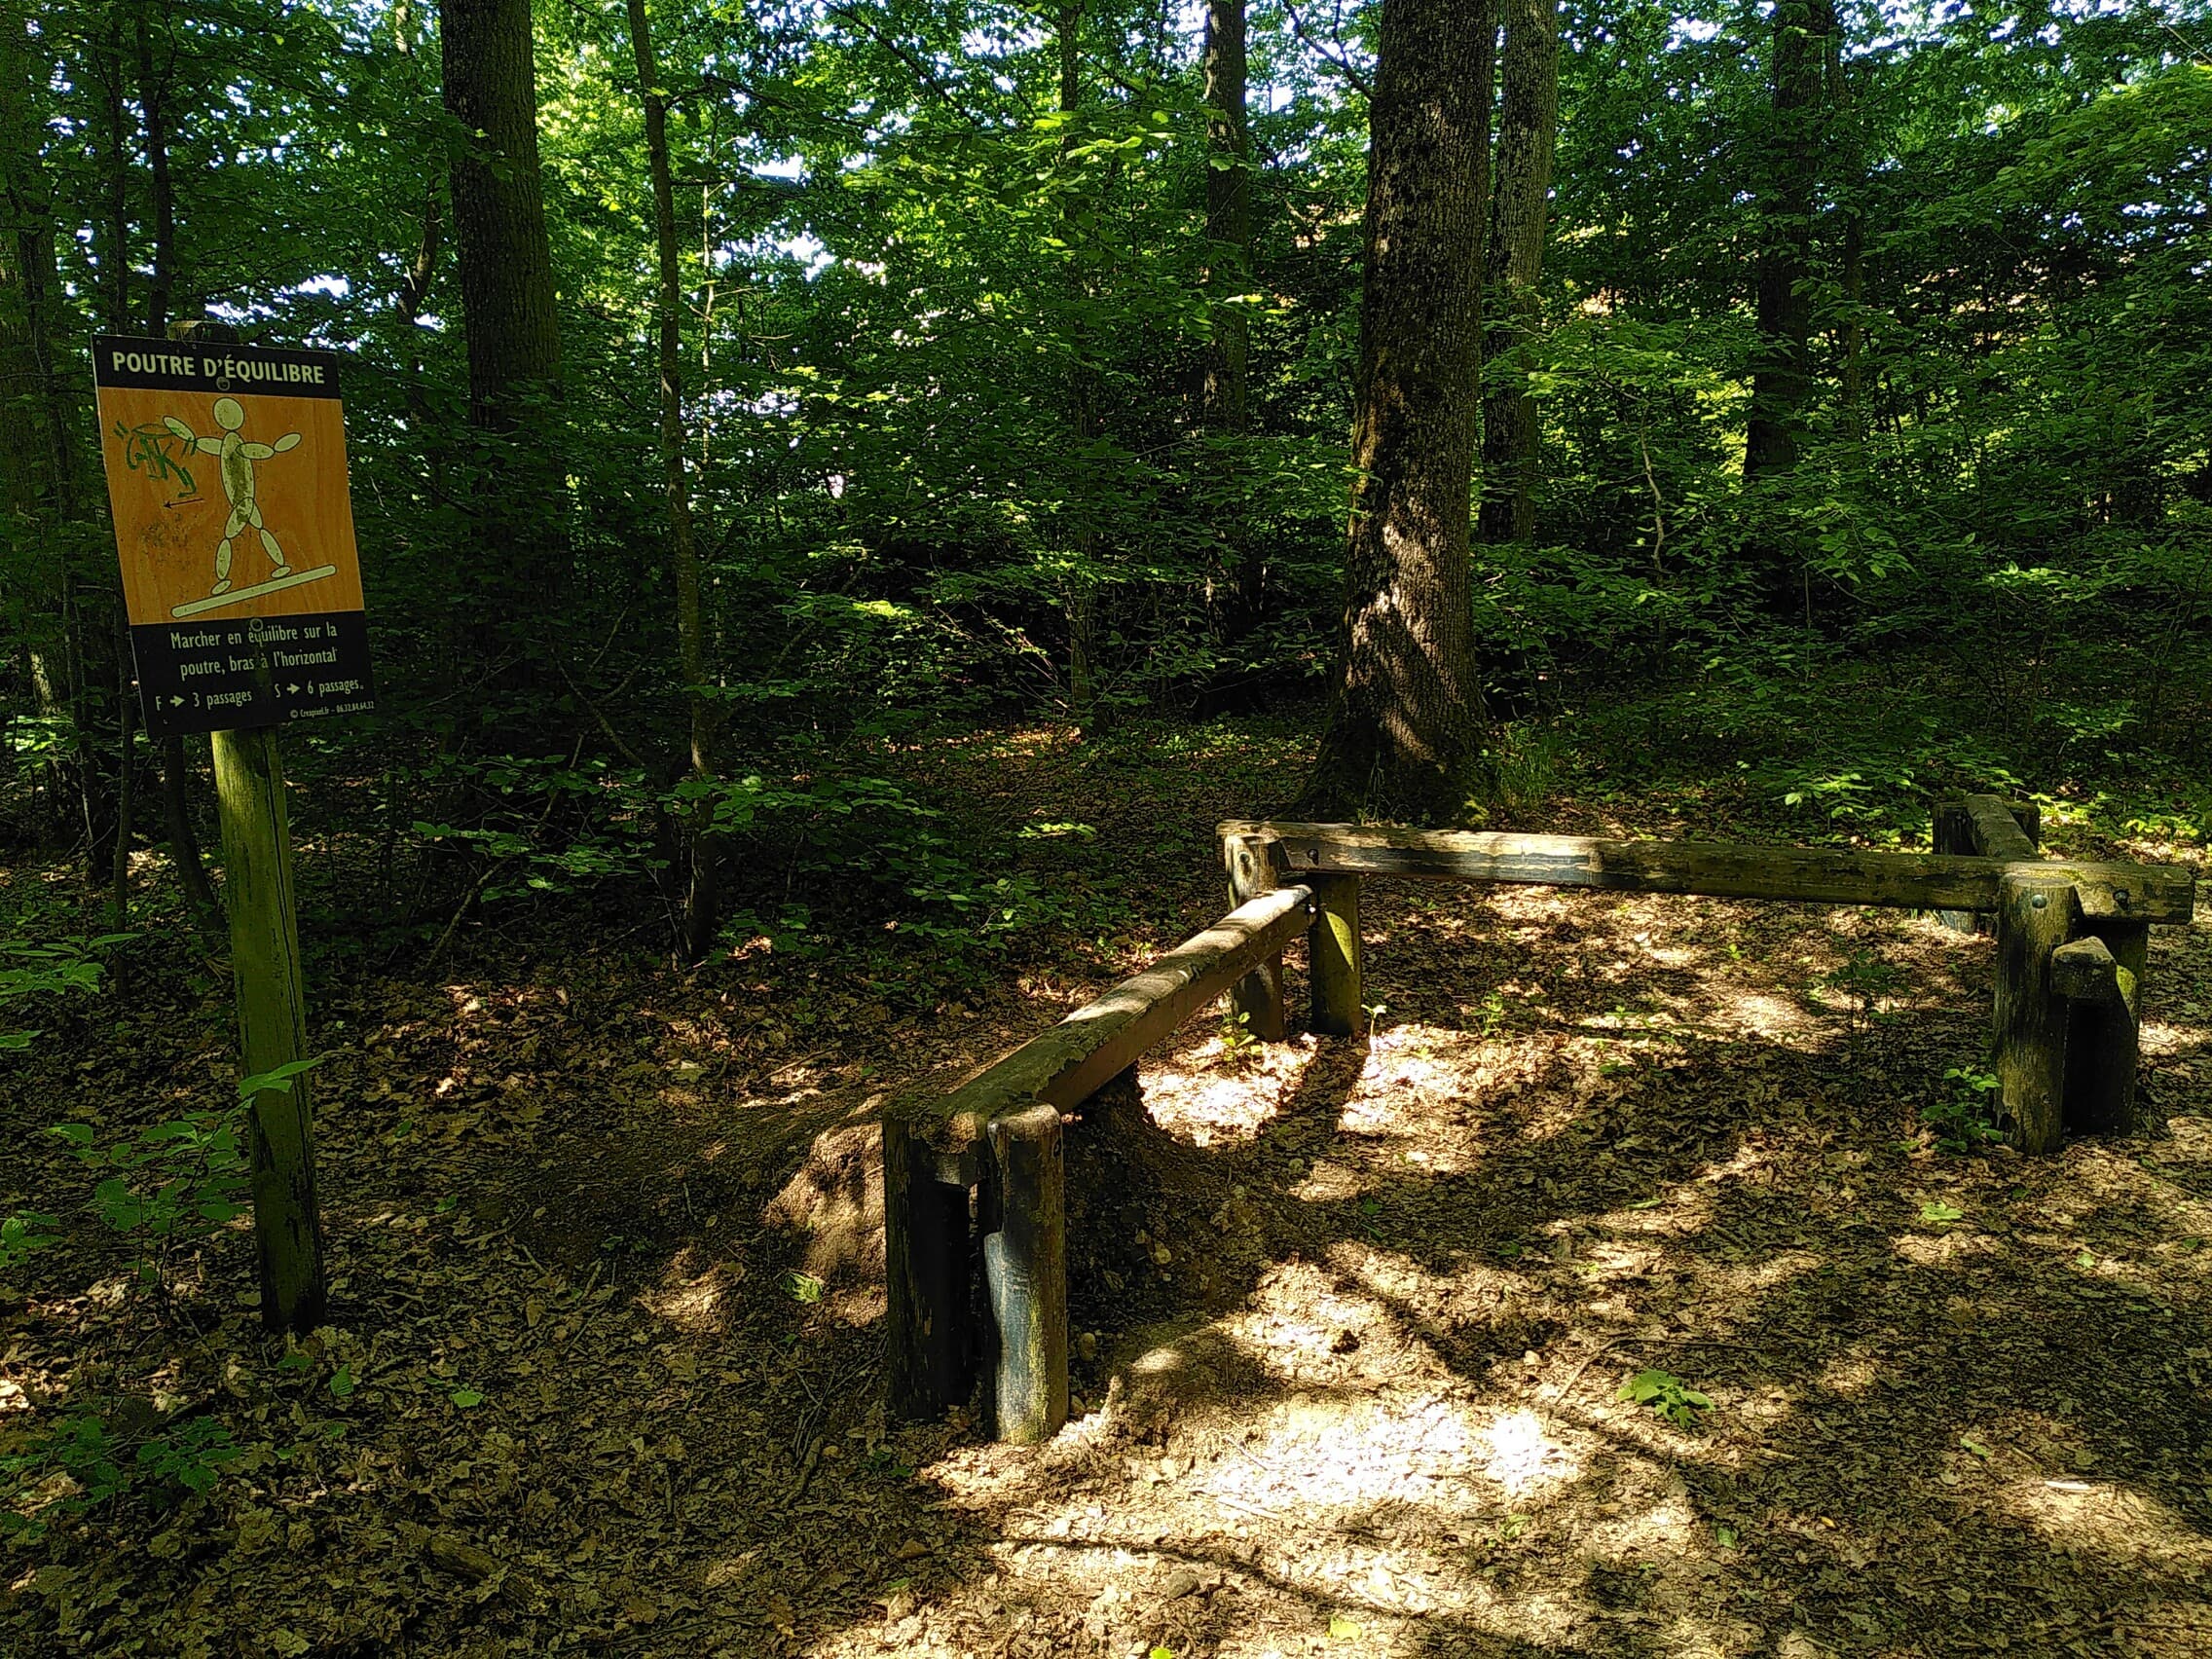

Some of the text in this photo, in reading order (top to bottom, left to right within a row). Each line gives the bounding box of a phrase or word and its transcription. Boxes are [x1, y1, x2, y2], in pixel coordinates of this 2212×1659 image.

[112, 351, 325, 384] POUTRE D'ÉQUILIBRE
[170, 621, 338, 649] Marcher en équilibre sur la
[180, 646, 337, 682] poutre, bras à l'horizontal
[156, 695, 162, 711] F
[194, 693, 201, 708] 3
[206, 689, 252, 710] passages
[275, 683, 281, 698] S
[307, 680, 313, 694] 6
